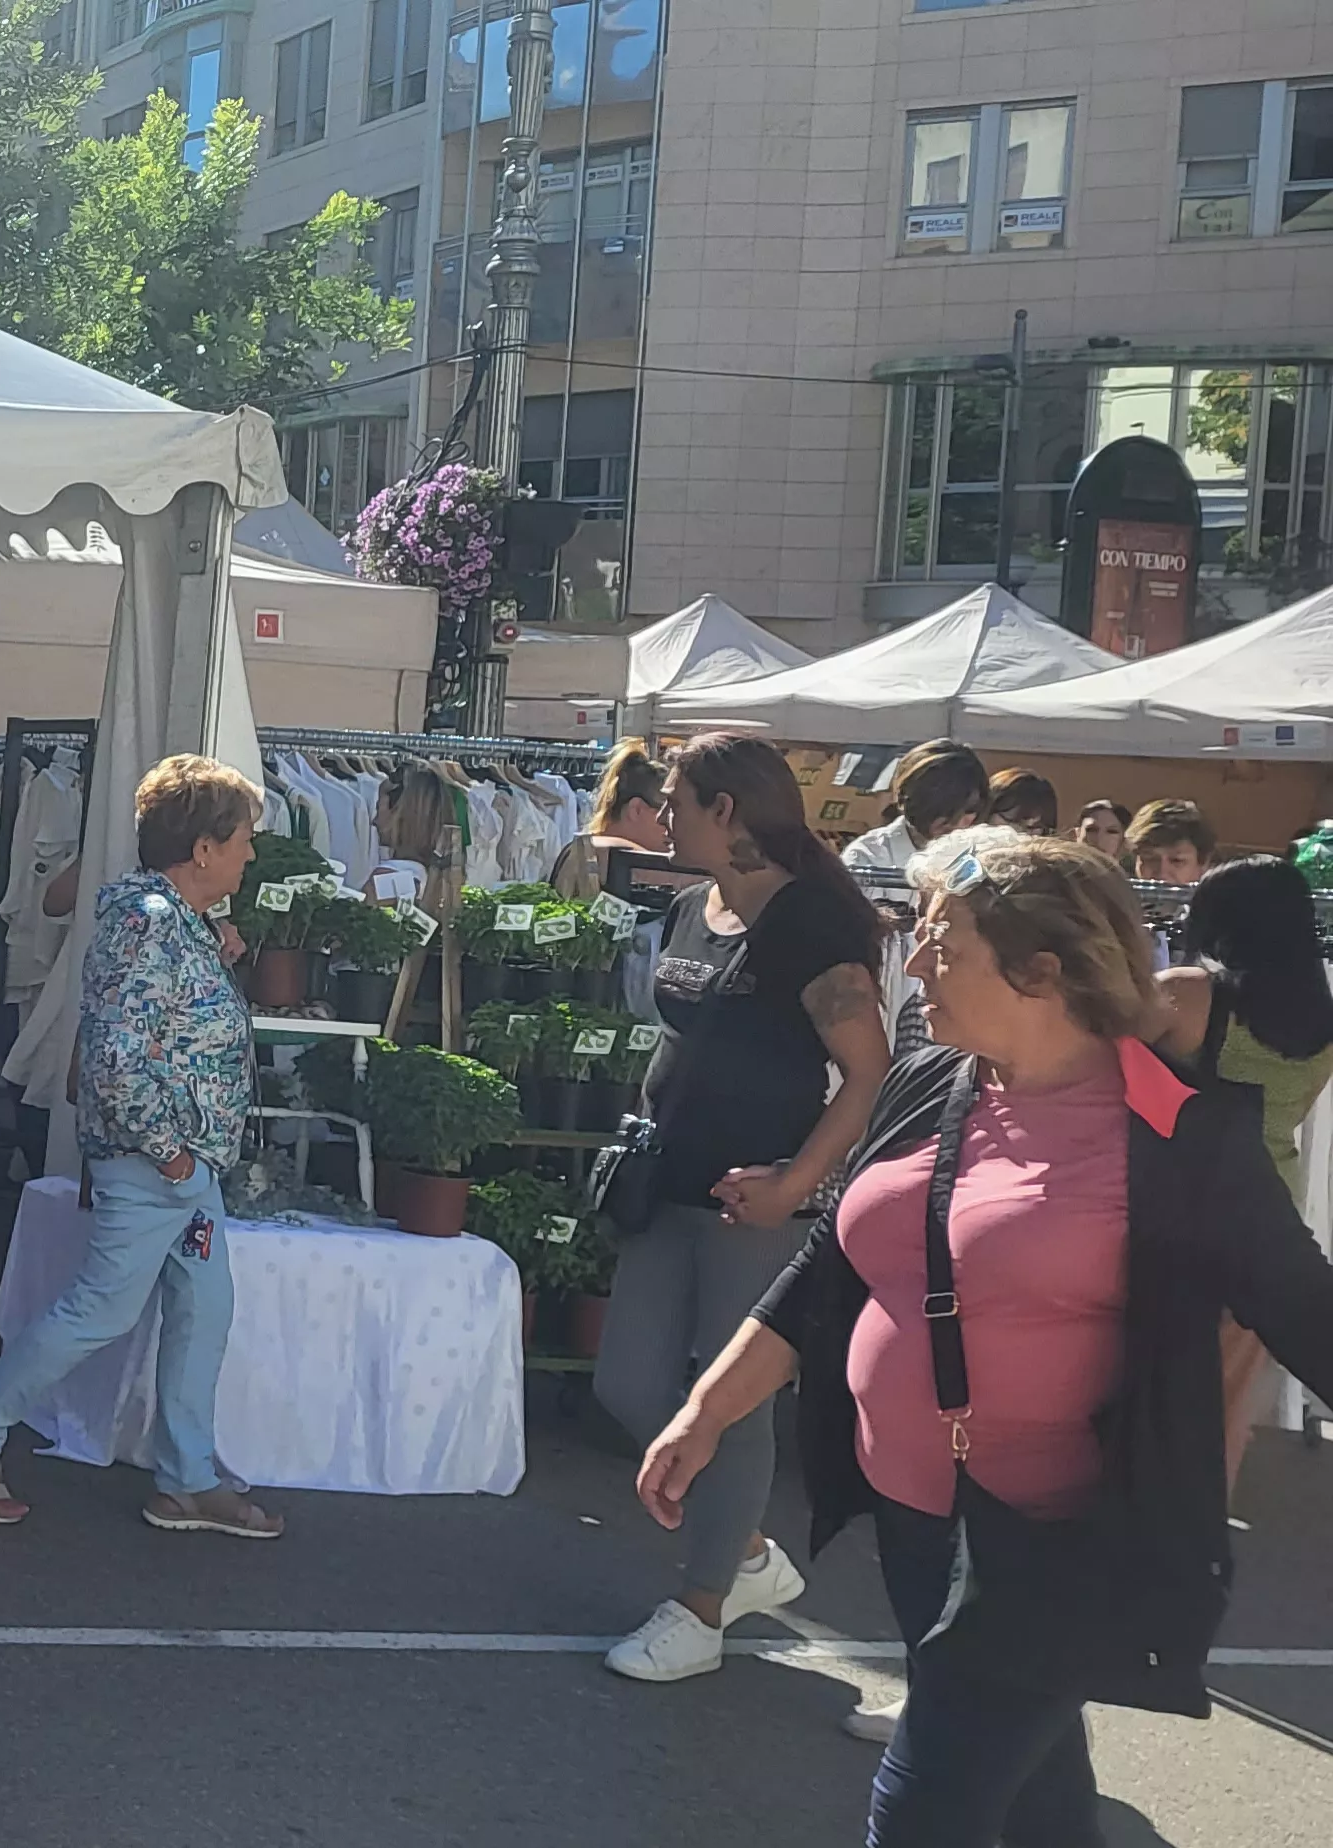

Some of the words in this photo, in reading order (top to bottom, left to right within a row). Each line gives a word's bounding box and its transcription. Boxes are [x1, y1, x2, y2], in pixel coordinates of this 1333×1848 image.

[1021, 211, 1061, 221] REALE
[926, 217, 965, 227] REALE
[1100, 548, 1130, 568] CON
[1132, 551, 1187, 572] TIEMPO
